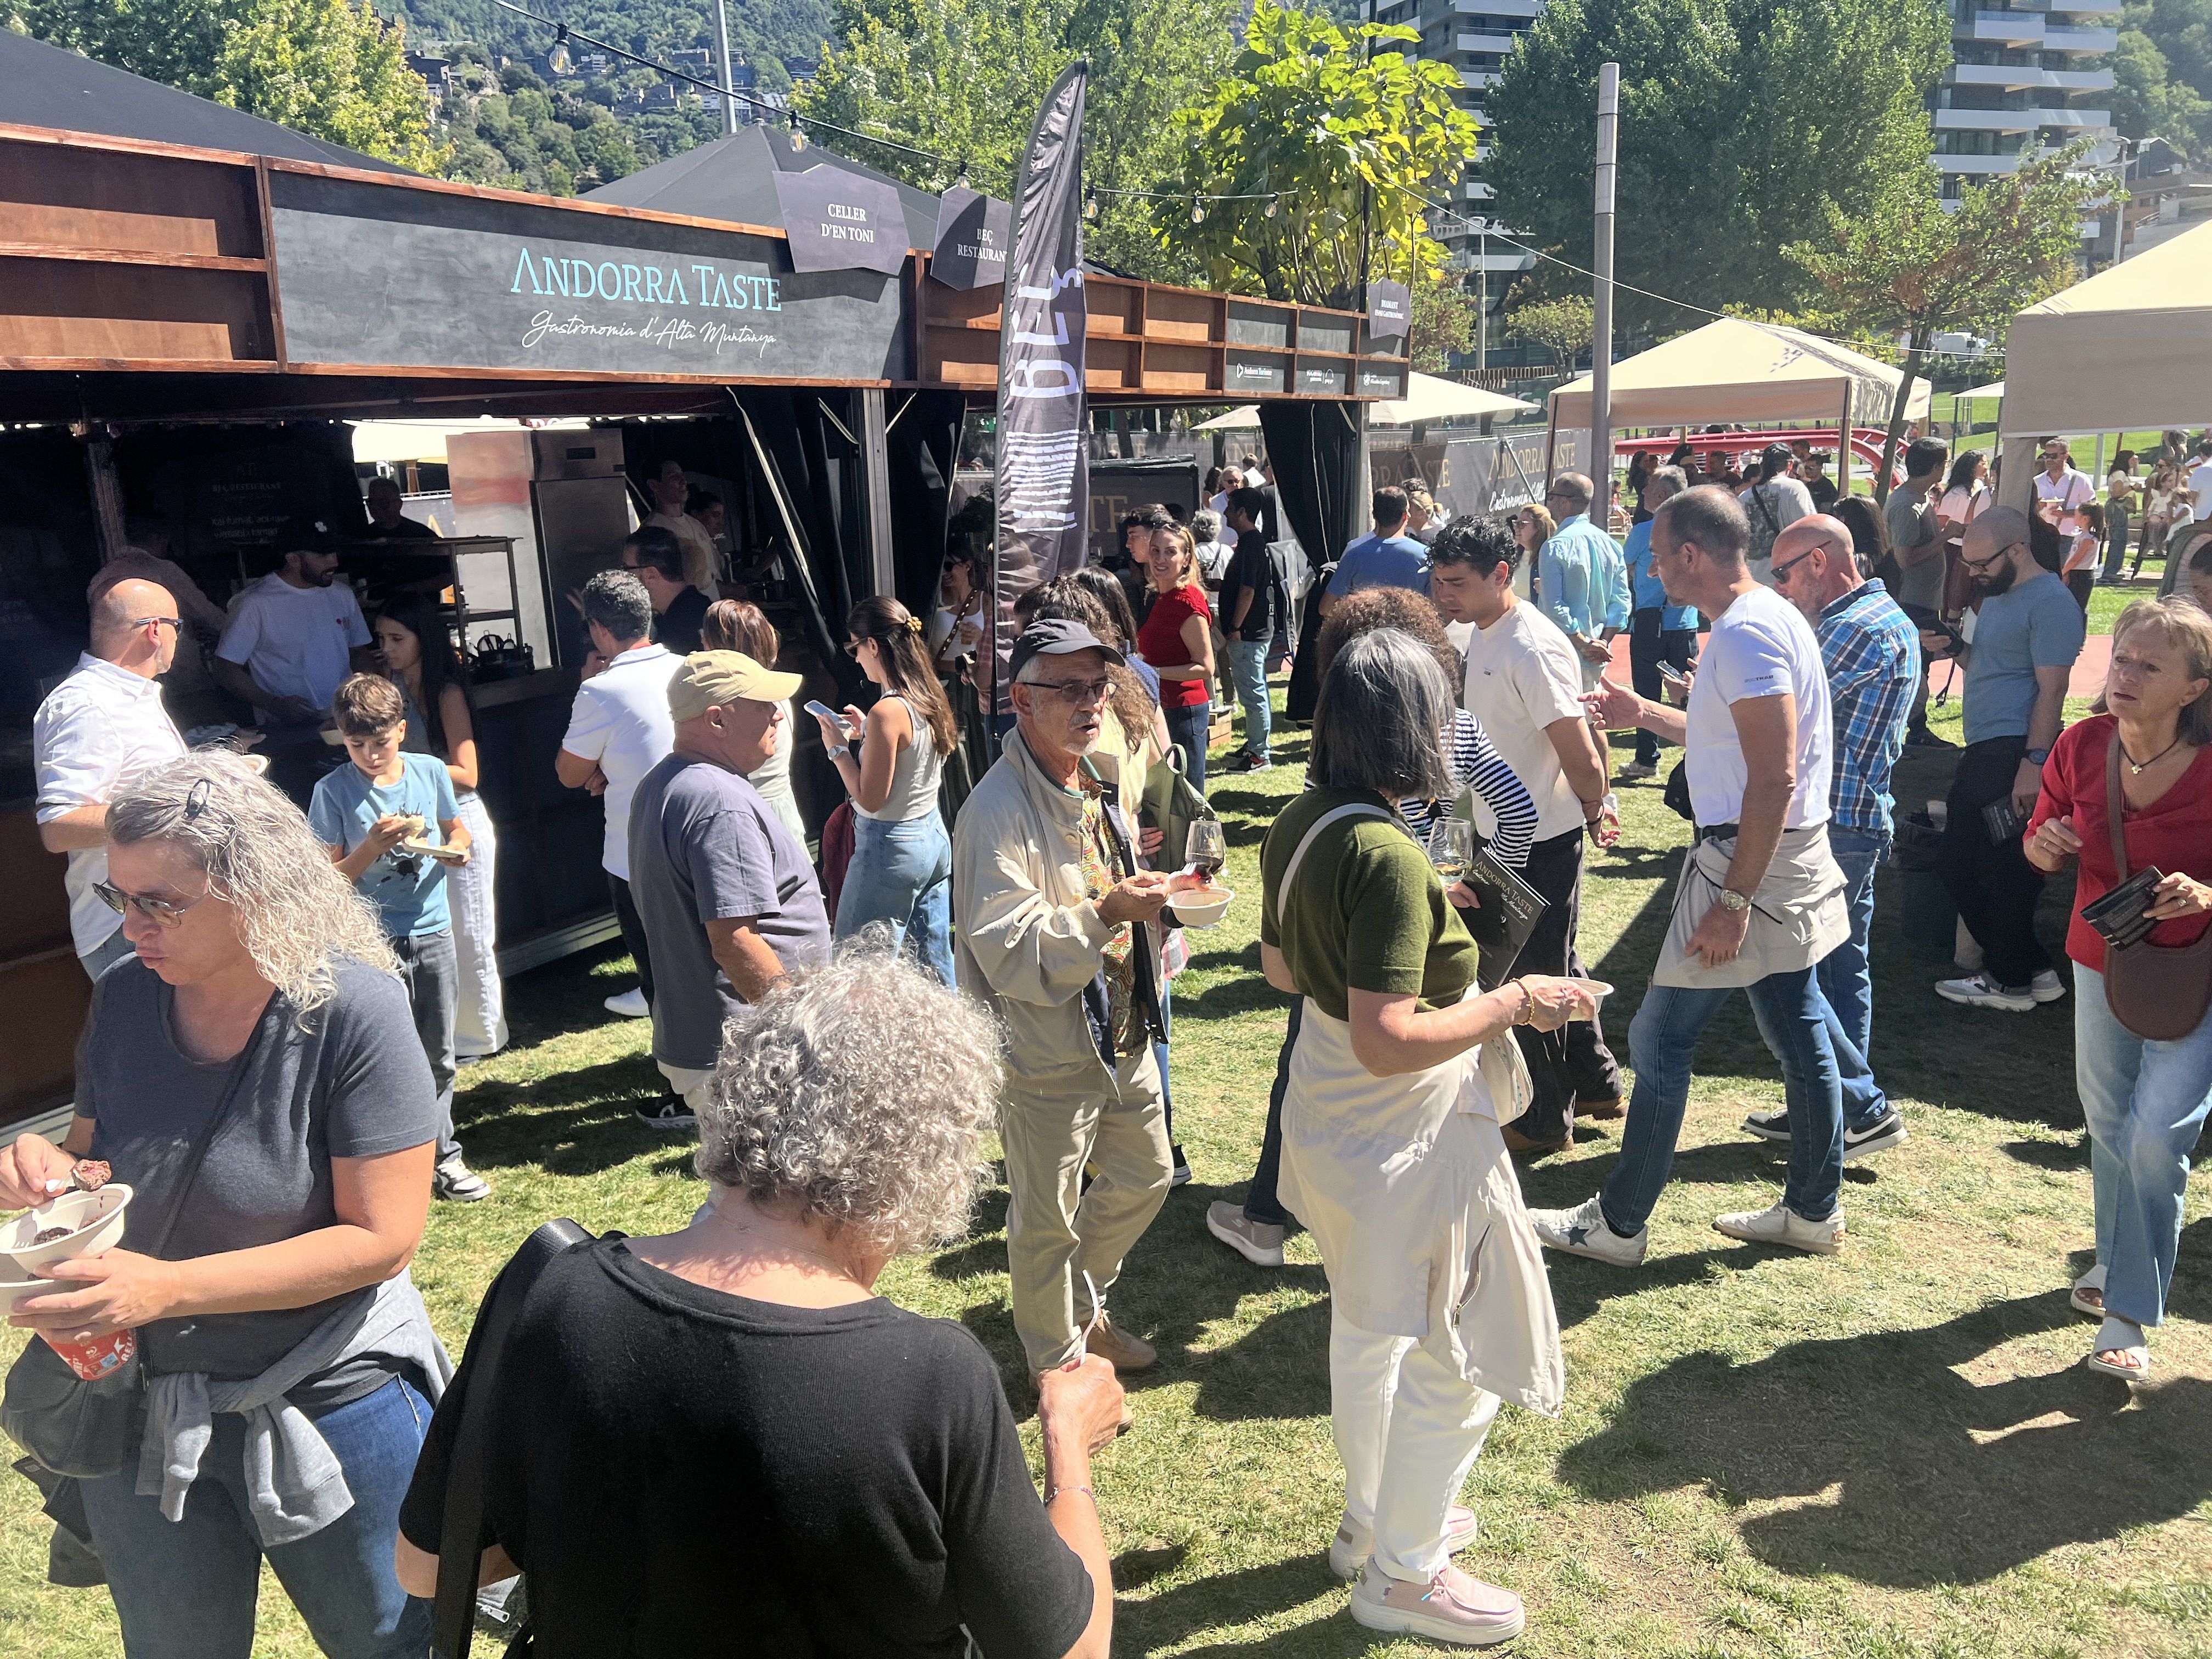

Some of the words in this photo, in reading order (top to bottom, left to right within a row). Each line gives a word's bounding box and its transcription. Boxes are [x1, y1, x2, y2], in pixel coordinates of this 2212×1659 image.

[827, 204, 867, 222] CELLER
[821, 223, 847, 240] D'EN
[848, 227, 874, 244] TONI
[977, 228, 994, 246] BEÇ
[957, 244, 1007, 263] RESTAURAN
[510, 247, 690, 305] ANDORRA
[691, 264, 782, 312] TASTE
[521, 309, 636, 348] Gastronomia
[699, 321, 777, 358] Muntanya
[1488, 446, 1546, 481] ANDORRA
[1553, 442, 1576, 469] ASTE
[1476, 861, 1511, 895] ANDORRA
[1511, 889, 1534, 914] TASTE
